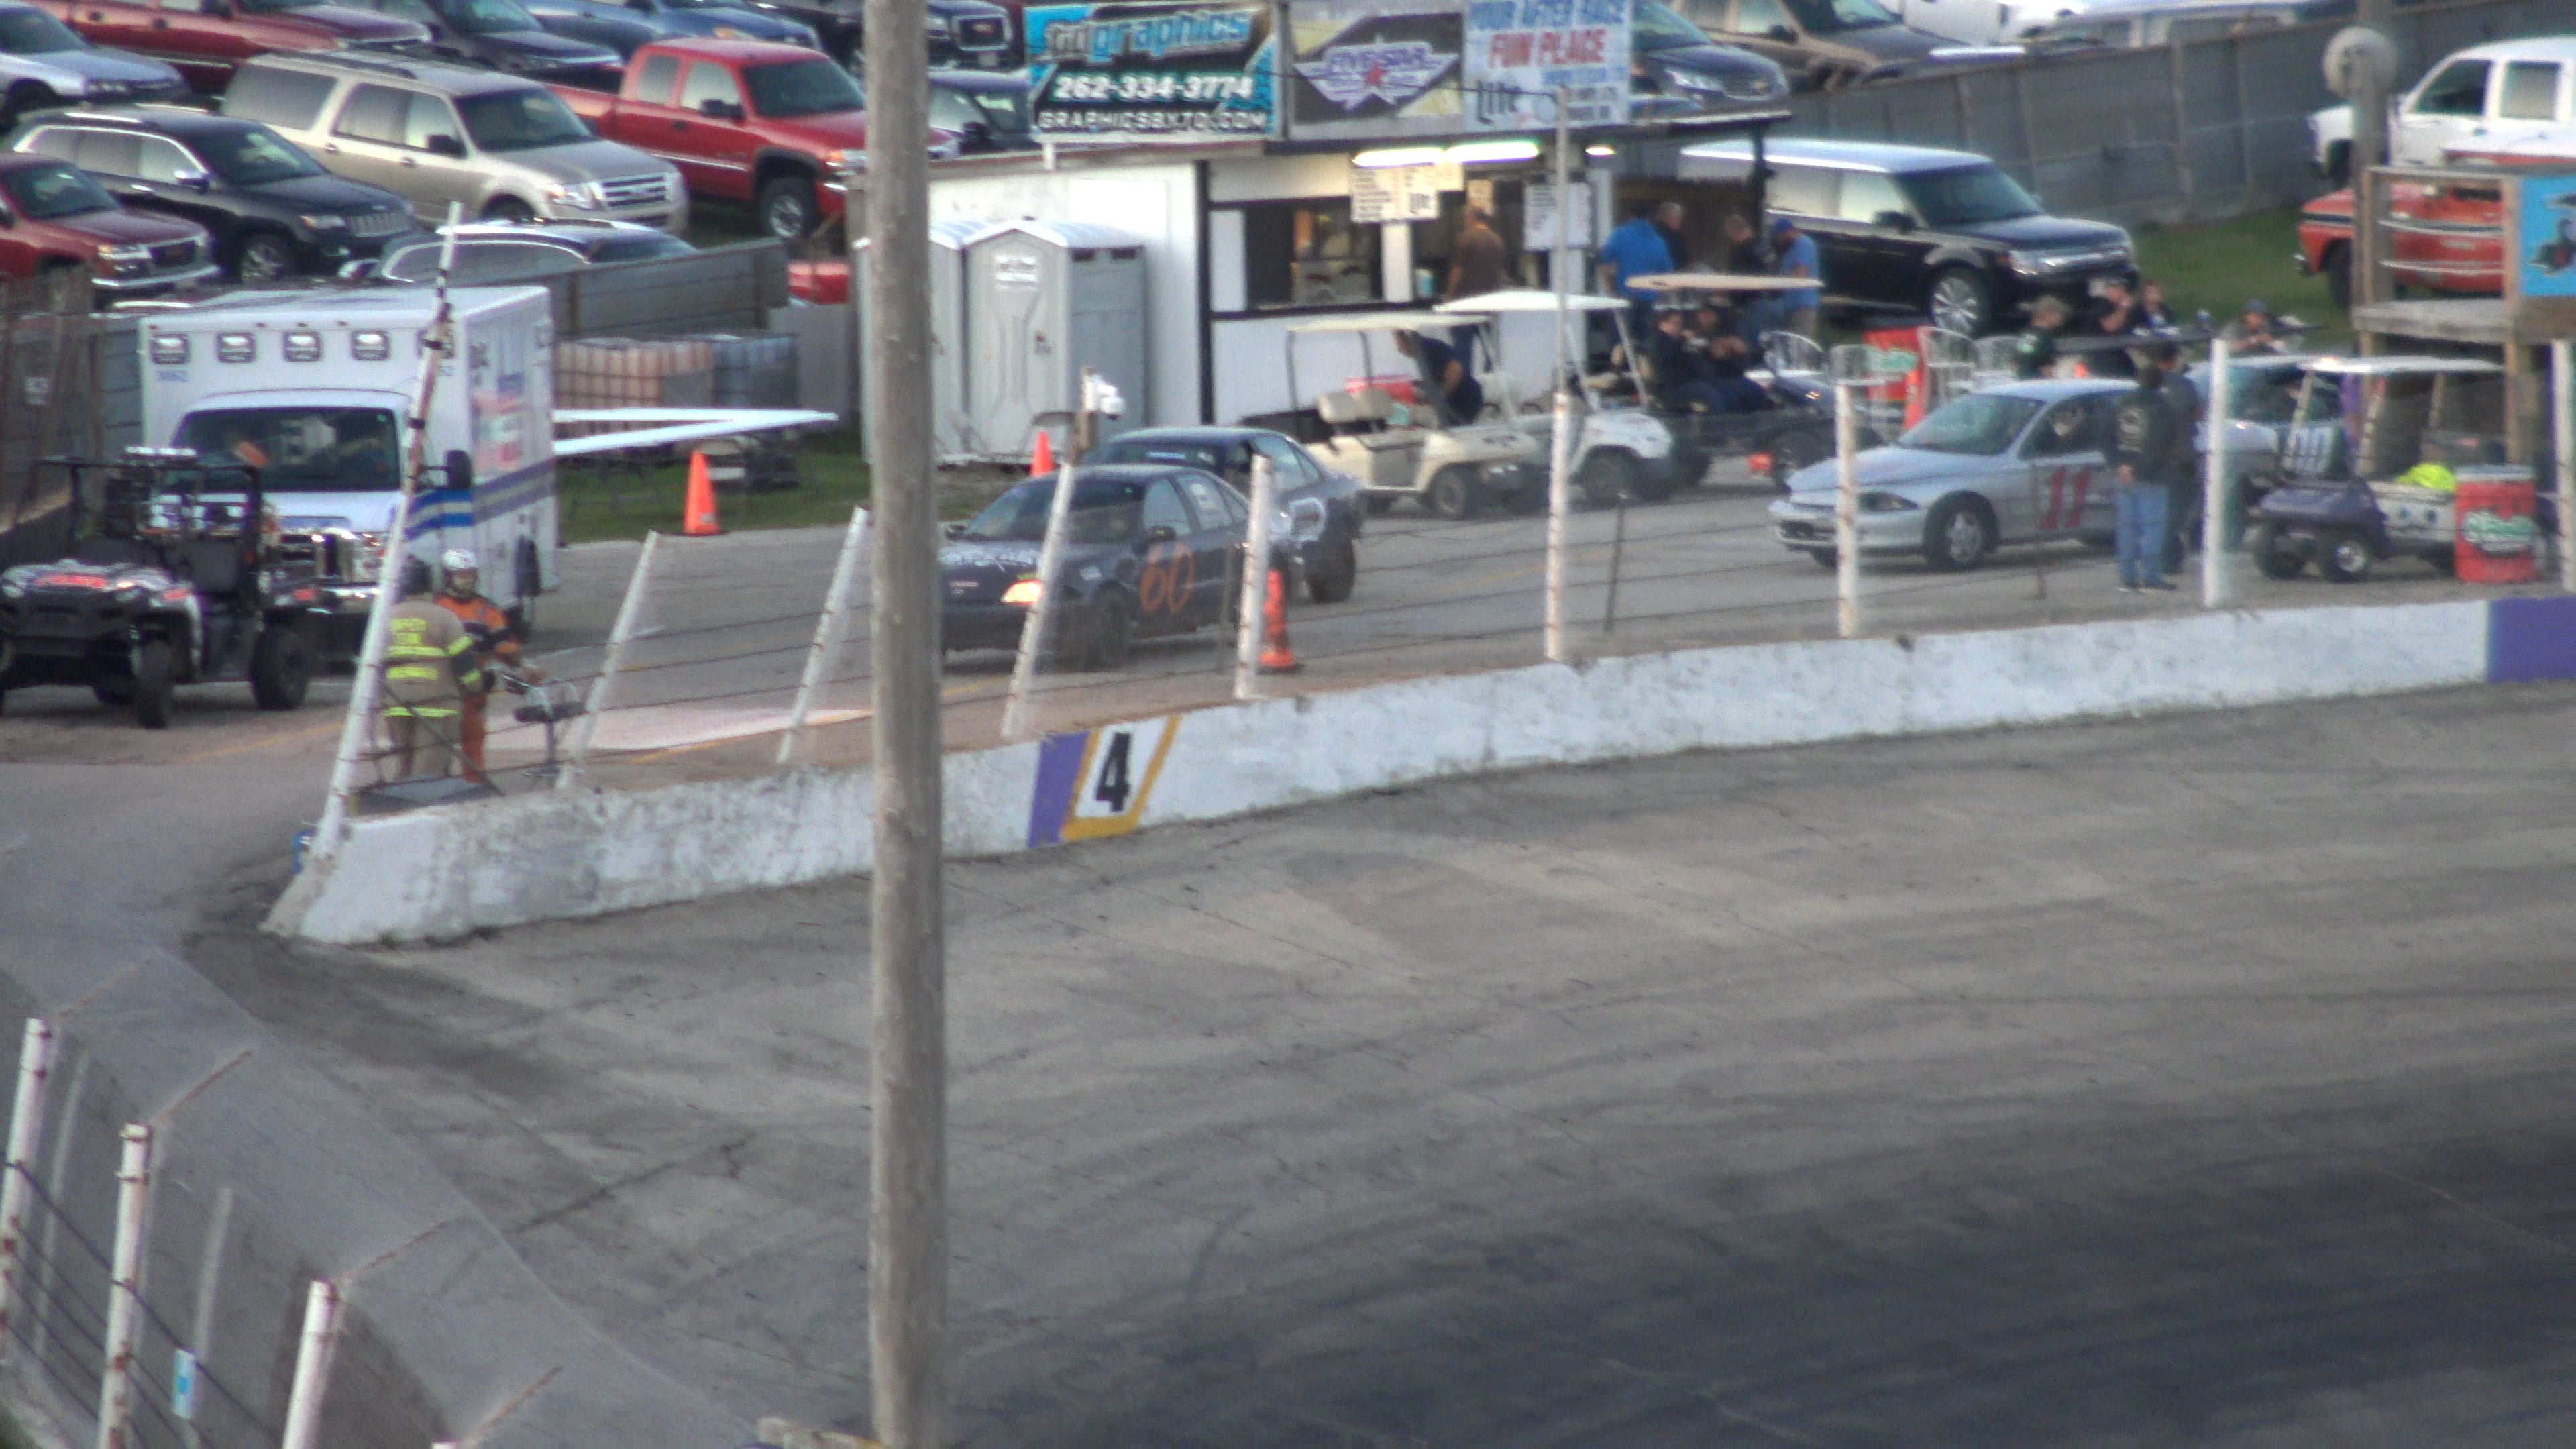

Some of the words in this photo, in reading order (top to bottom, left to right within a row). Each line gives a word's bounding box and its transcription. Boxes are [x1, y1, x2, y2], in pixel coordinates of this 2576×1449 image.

[1489, 33, 1535, 68] FUN
[1539, 28, 1607, 66] PLACE
[1050, 75, 1253, 101] 262-334-3774
[2038, 463, 2090, 530] 11
[1139, 541, 1194, 616] 60
[1095, 731, 1132, 813] 4
